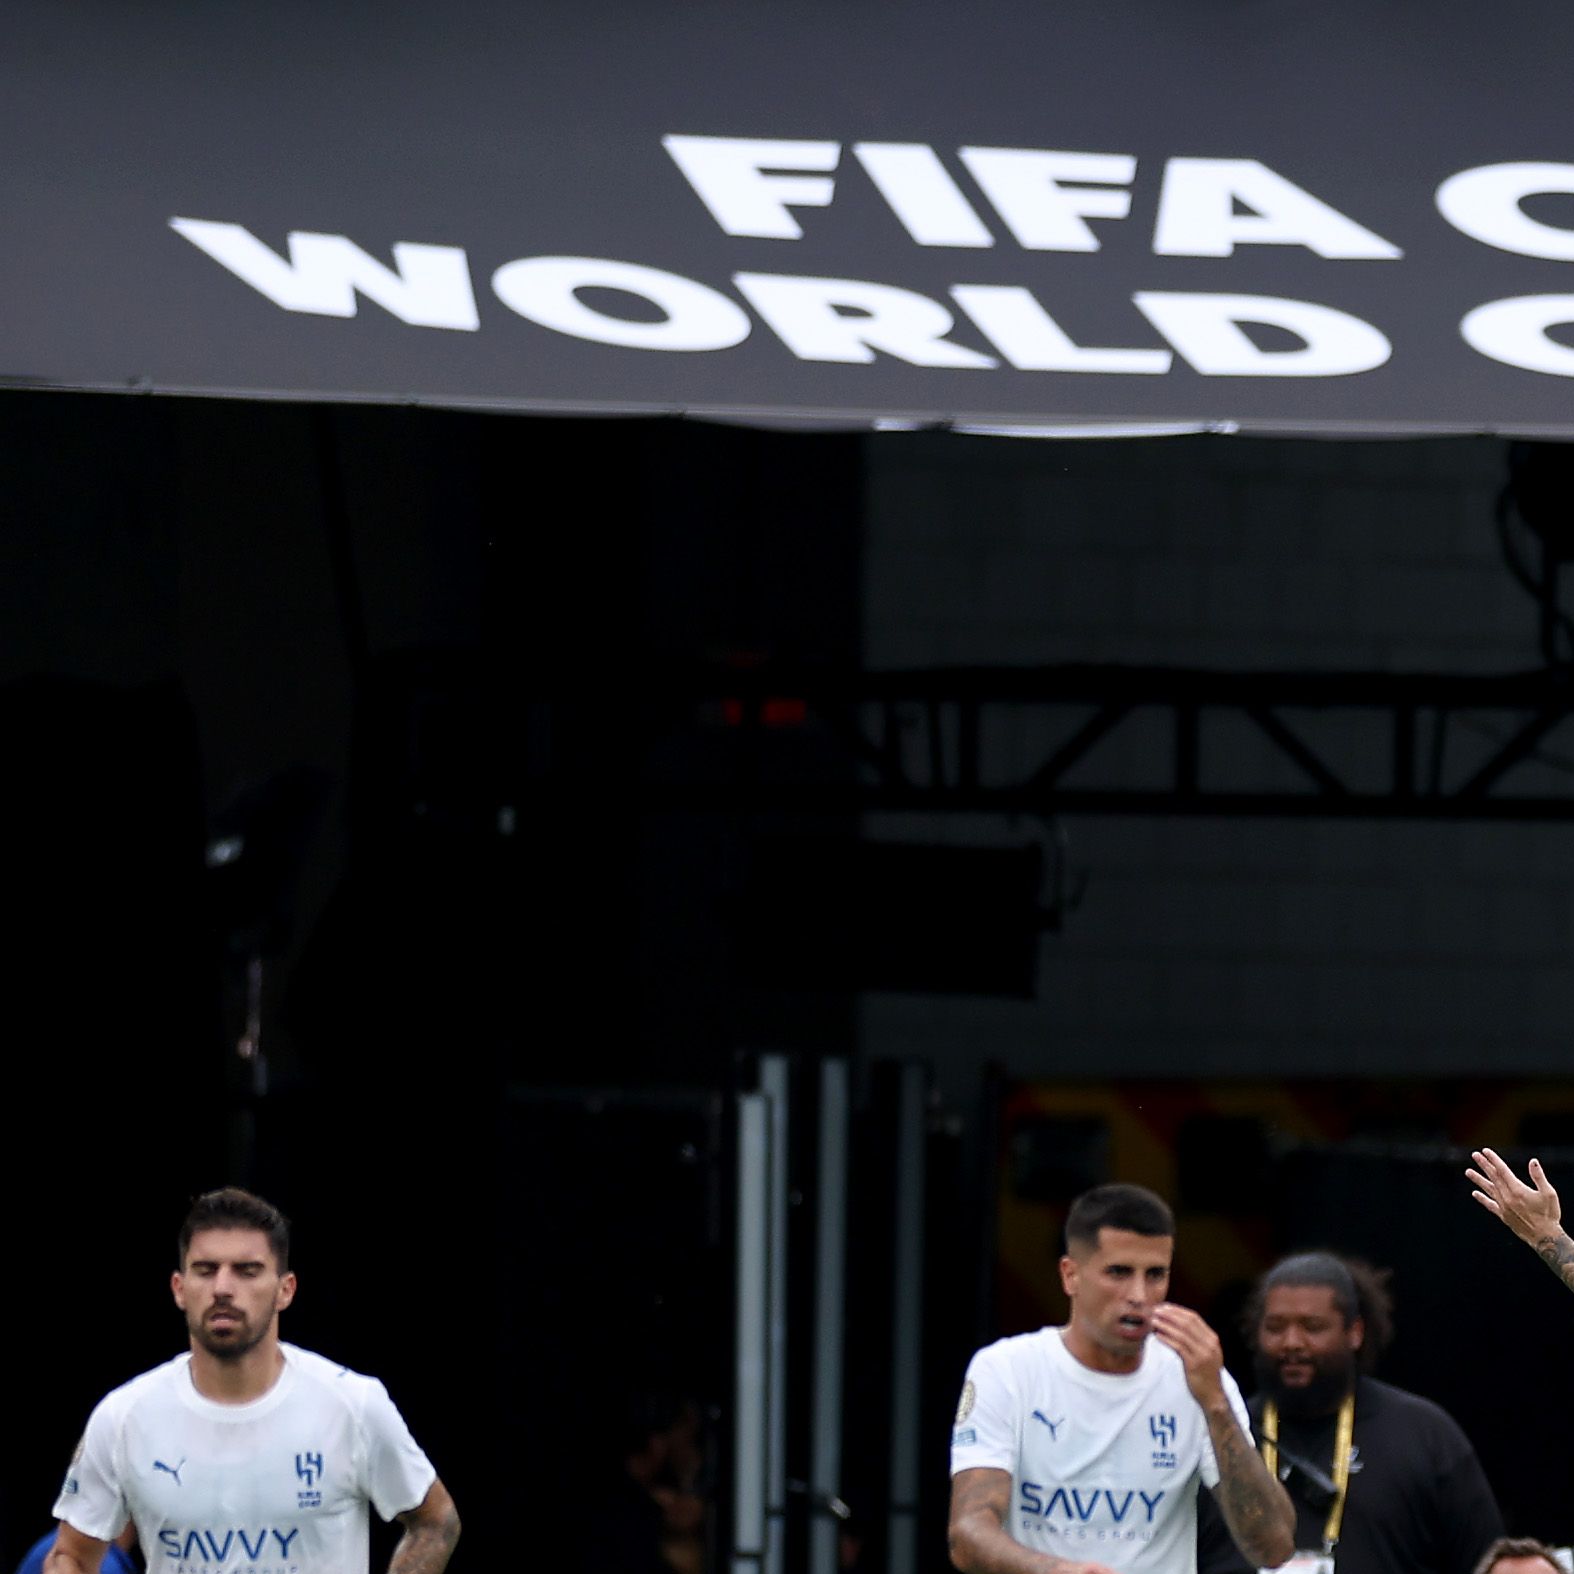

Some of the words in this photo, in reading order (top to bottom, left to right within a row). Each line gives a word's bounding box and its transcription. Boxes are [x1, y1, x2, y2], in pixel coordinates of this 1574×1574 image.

[663, 134, 1401, 260] FIFA
[170, 217, 1392, 377] WORLD
[1020, 1481, 1165, 1522] SAVVY
[158, 1529, 299, 1562] SAVVY
